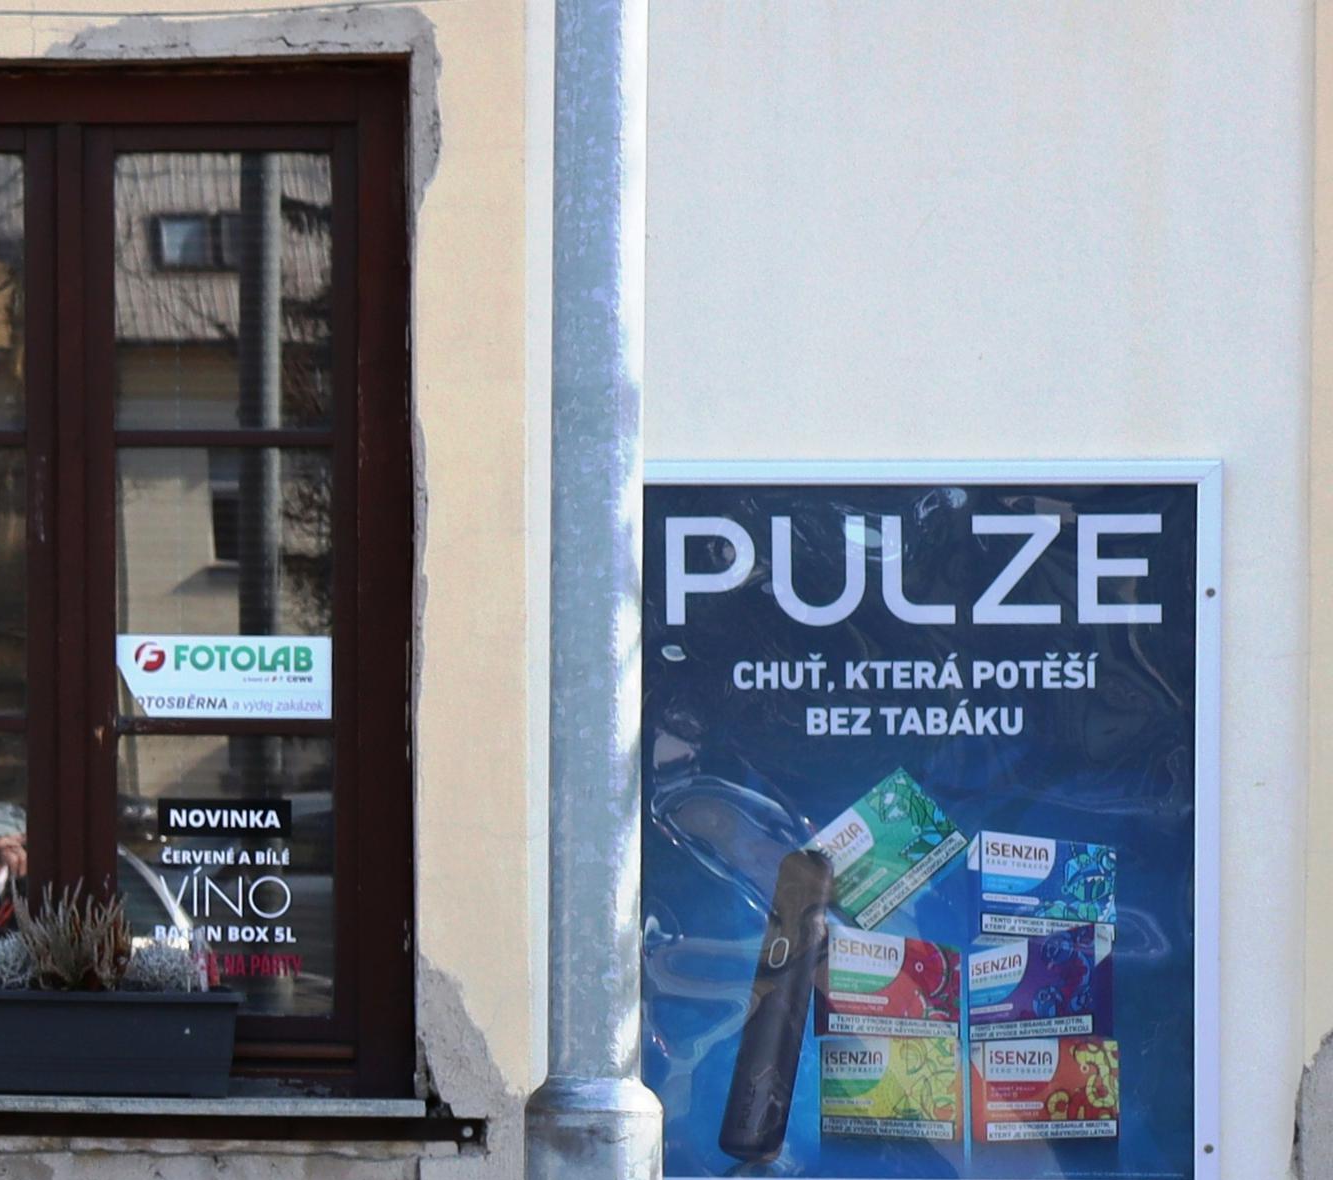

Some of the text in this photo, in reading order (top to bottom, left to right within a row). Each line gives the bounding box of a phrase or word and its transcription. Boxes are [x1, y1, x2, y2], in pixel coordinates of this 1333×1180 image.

[664, 513, 1162, 626] PULZE
[174, 645, 313, 672] FOTOLAB
[733, 652, 1097, 693] CHUŤ, KTERÁ POTĚŠÍ
[138, 694, 228, 710] OTOSBĚRNA
[276, 699, 323, 712] zakázek
[805, 699, 1025, 736] BEZ TABÁKU
[169, 809, 281, 828] NOVINKA
[162, 846, 290, 865] ČERVENÉ A BÍLÉ
[160, 866, 291, 919] VÍNO
[228, 926, 270, 942] BOX
[274, 927, 296, 943] 5L
[225, 953, 246, 977] NA
